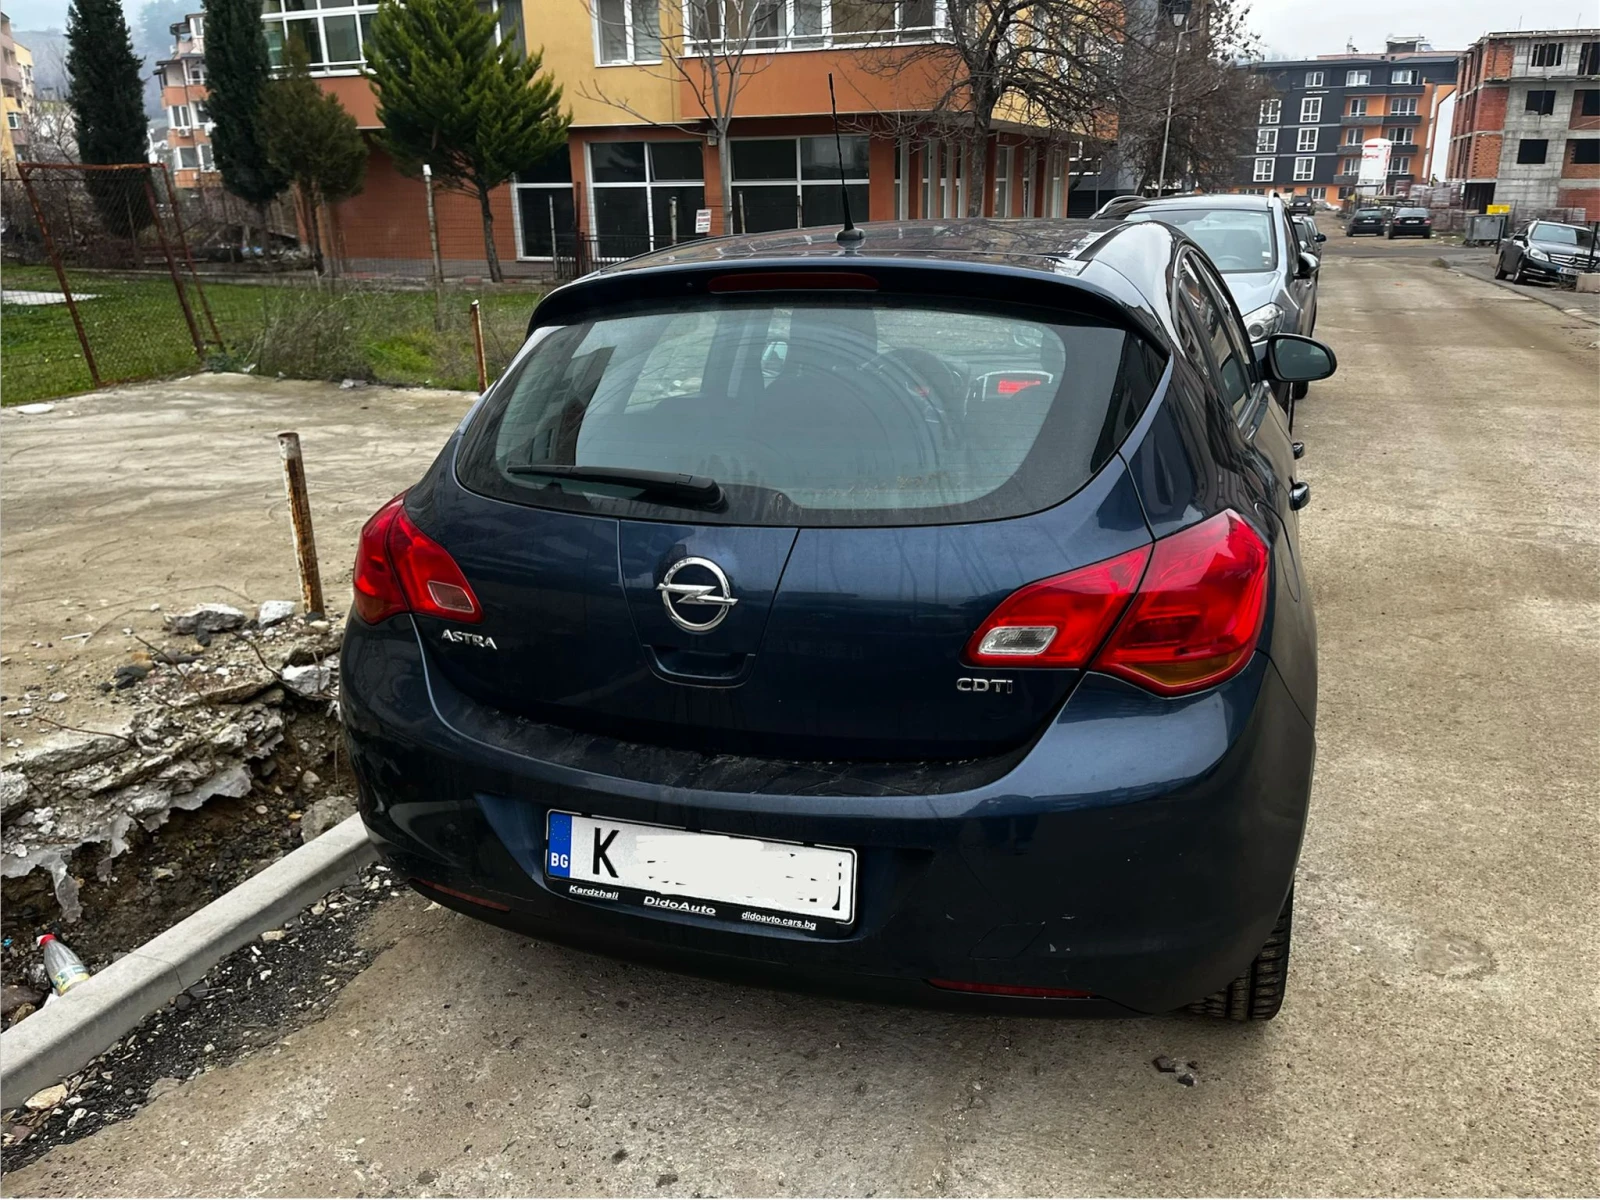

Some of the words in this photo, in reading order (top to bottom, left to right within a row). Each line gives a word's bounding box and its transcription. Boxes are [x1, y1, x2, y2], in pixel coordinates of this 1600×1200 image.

[441, 629, 498, 650] ASTRA
[550, 852, 569, 869] BG
[592, 827, 620, 878] K
[569, 884, 619, 900] Kardzhali
[643, 896, 716, 916] DidoAuto
[741, 911, 817, 930] didoavto.cars.bg
